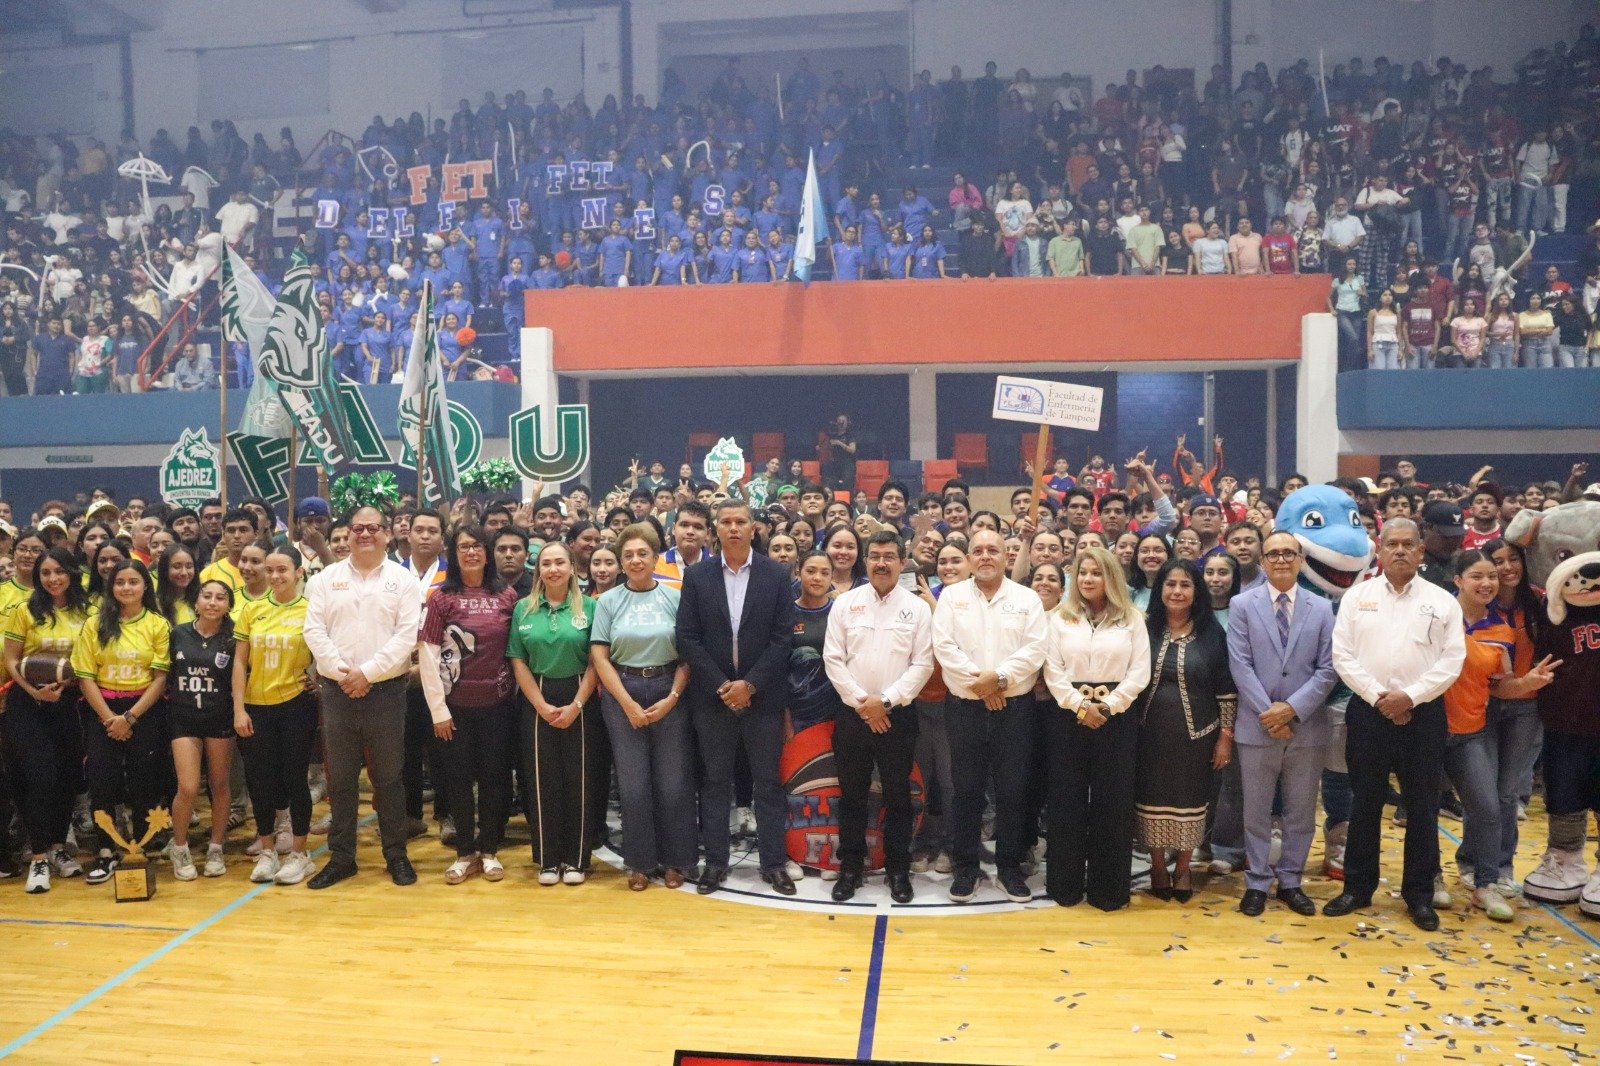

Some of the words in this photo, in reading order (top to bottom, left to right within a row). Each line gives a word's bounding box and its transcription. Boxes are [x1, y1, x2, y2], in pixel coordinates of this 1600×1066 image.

[1048, 389, 1085, 402] Facultad
[1087, 394, 1099, 403] de
[1045, 409, 1056, 418] de
[1059, 409, 1096, 423] Tampico
[295, 402, 344, 466] FADU
[168, 467, 213, 488] AJEDREZ
[459, 597, 499, 610] FCAT
[632, 602, 654, 613] UAT
[264, 651, 279, 669] 10
[187, 666, 210, 676] UAT
[194, 693, 202, 709] 1
